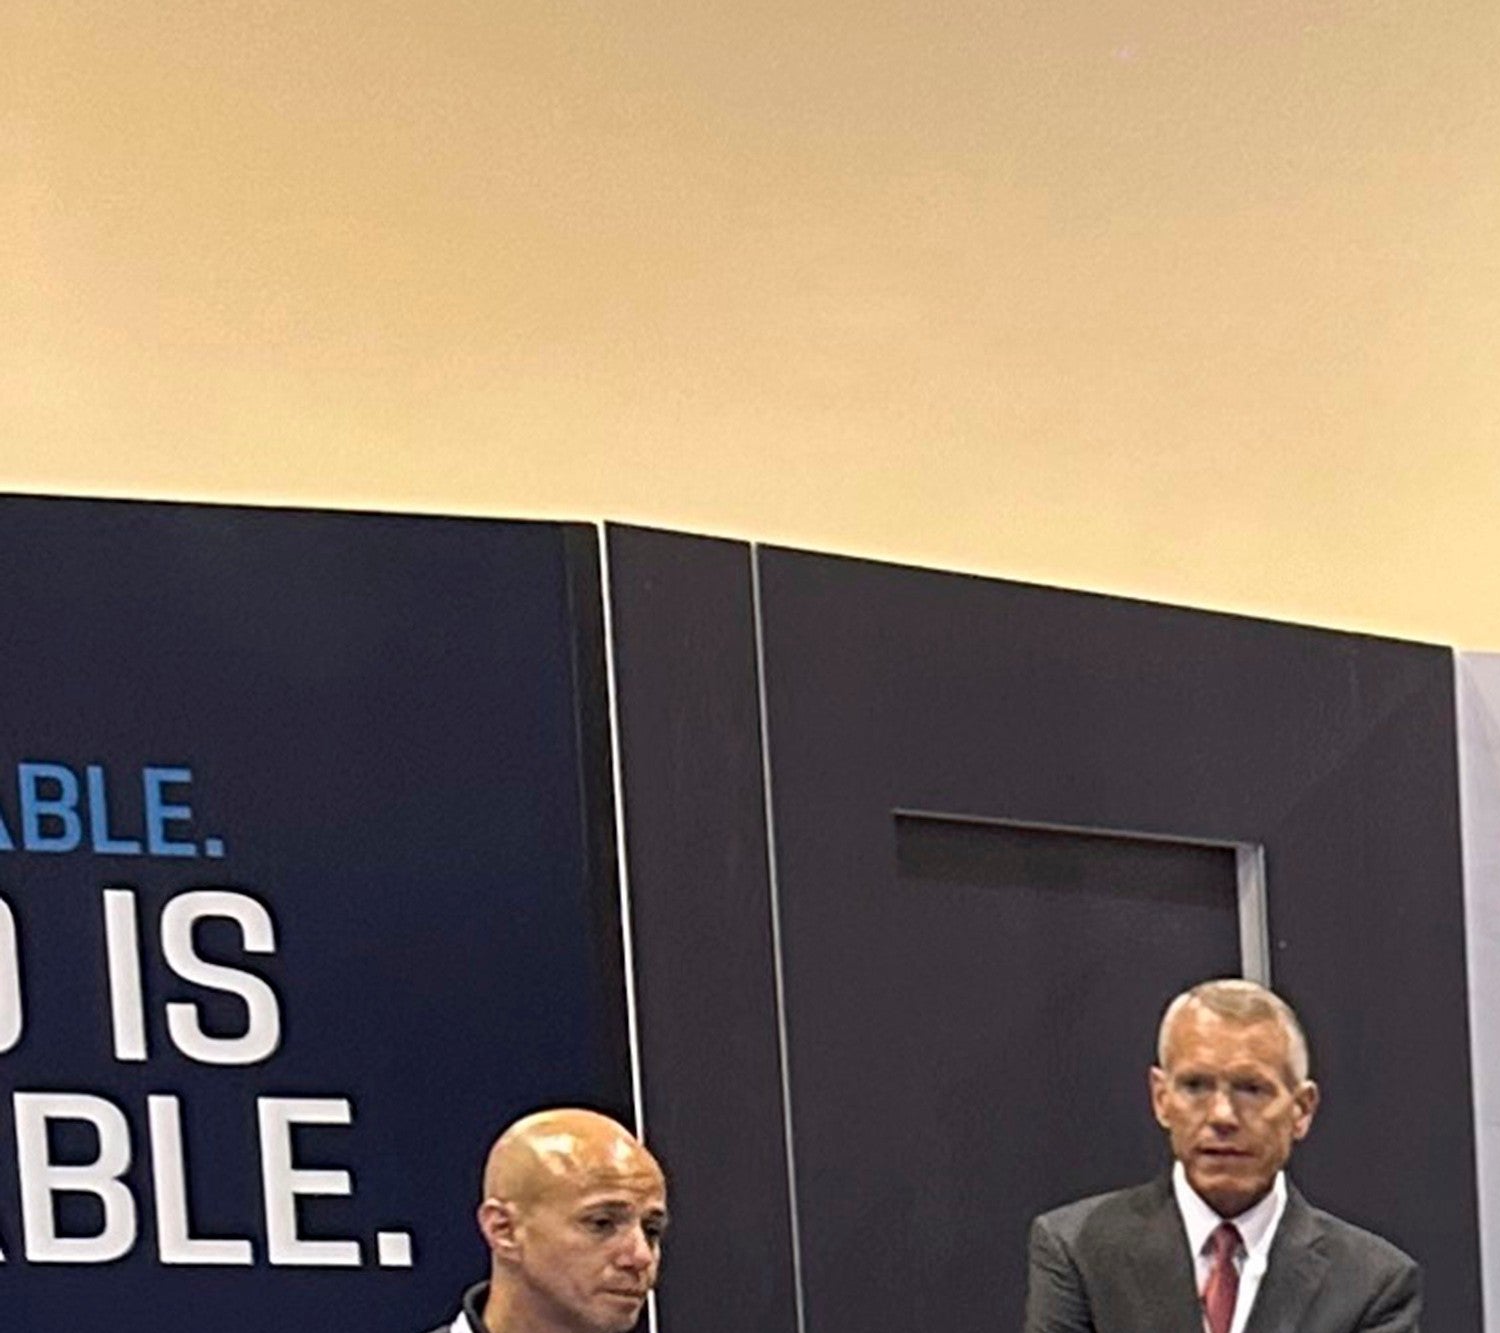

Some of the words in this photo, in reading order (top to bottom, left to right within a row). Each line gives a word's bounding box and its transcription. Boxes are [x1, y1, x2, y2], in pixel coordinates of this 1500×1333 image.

[0, 762, 226, 859] BLE.
[103, 888, 283, 1066] IS
[0, 1092, 414, 1267] BLE.
